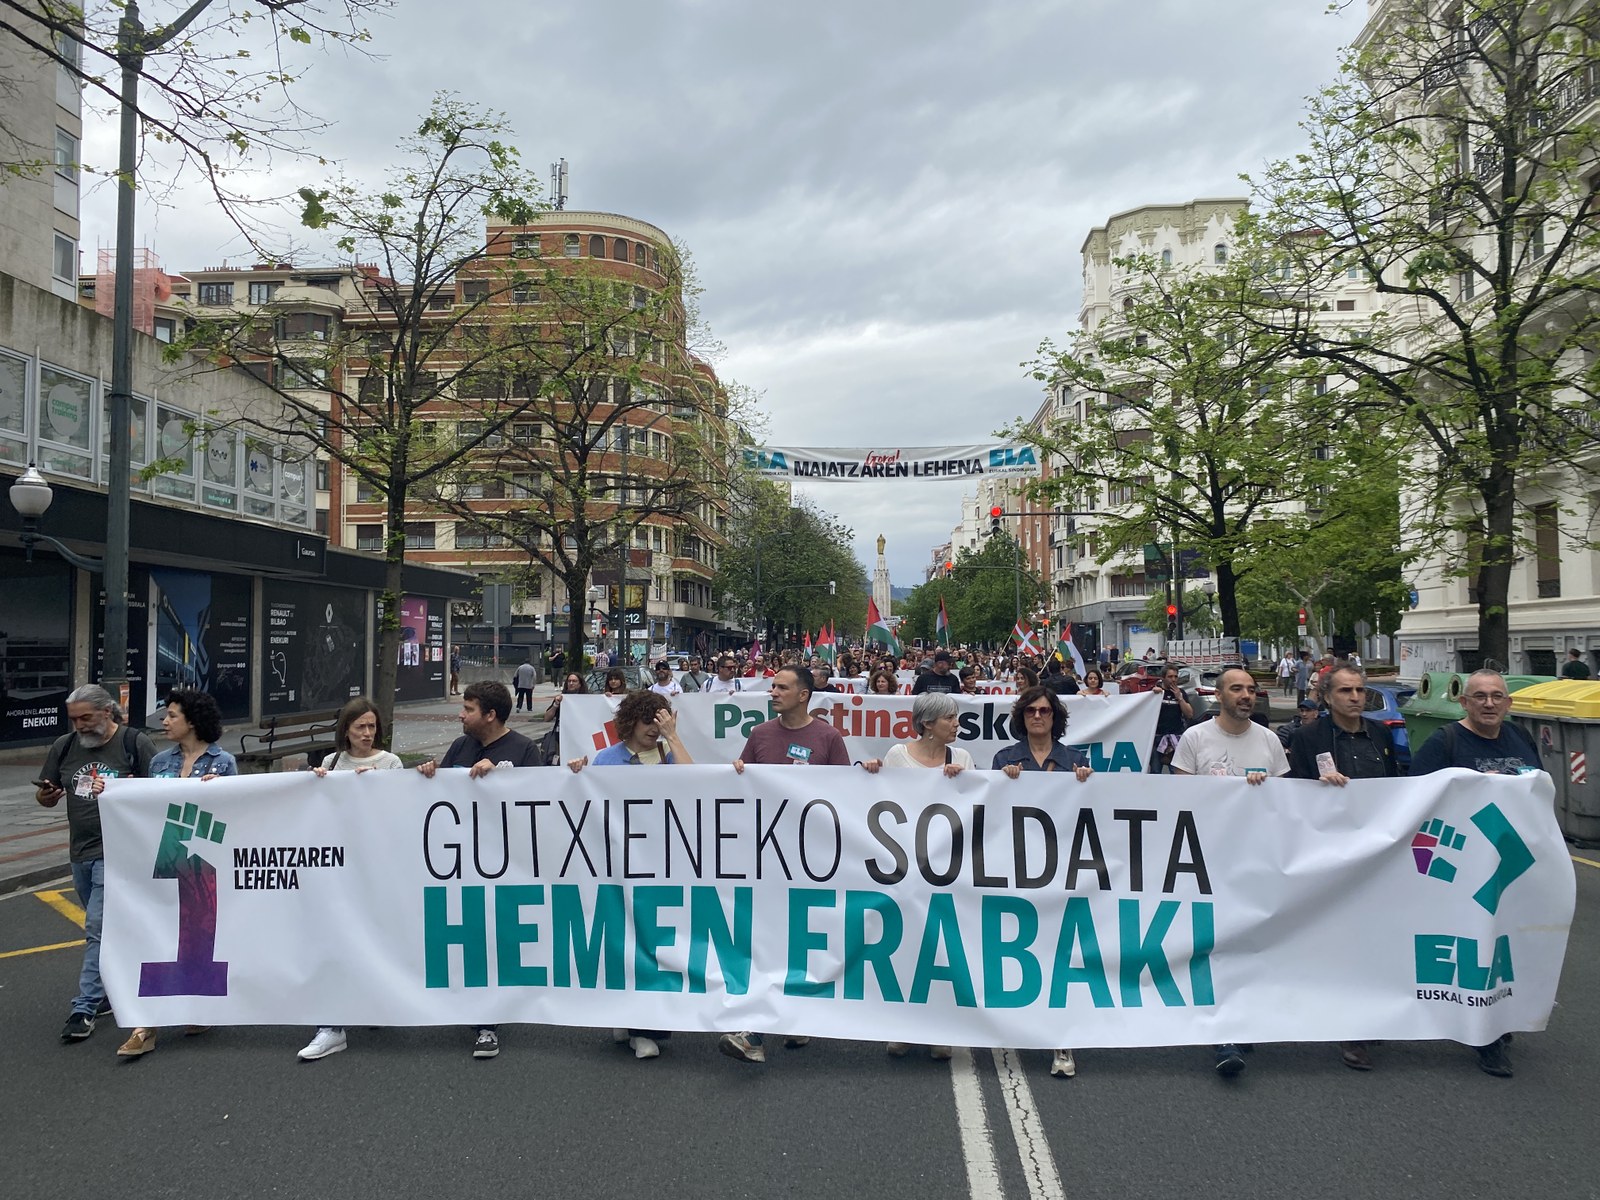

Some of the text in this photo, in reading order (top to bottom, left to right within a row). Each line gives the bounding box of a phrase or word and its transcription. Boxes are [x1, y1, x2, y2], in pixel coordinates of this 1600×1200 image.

[989, 447, 1036, 467] ELA
[284, 470, 303, 482] campus
[794, 458, 984, 478] MAIATZAREN LEHENA
[6, 709, 25, 717] AHORA
[51, 706, 58, 714] DE
[22, 716, 58, 729] ENEKURI
[790, 746, 807, 757] ELA
[1068, 741, 1142, 772] LA
[422, 798, 1213, 895] GUTXIENEKO SOLDATA
[233, 846, 345, 868] MAIATZAREN
[234, 869, 299, 890] LEHENA
[423, 883, 1216, 1009] HEMEN ERABAKI
[1414, 934, 1515, 991] ELA
[1416, 989, 1464, 1005] EUSKAL
